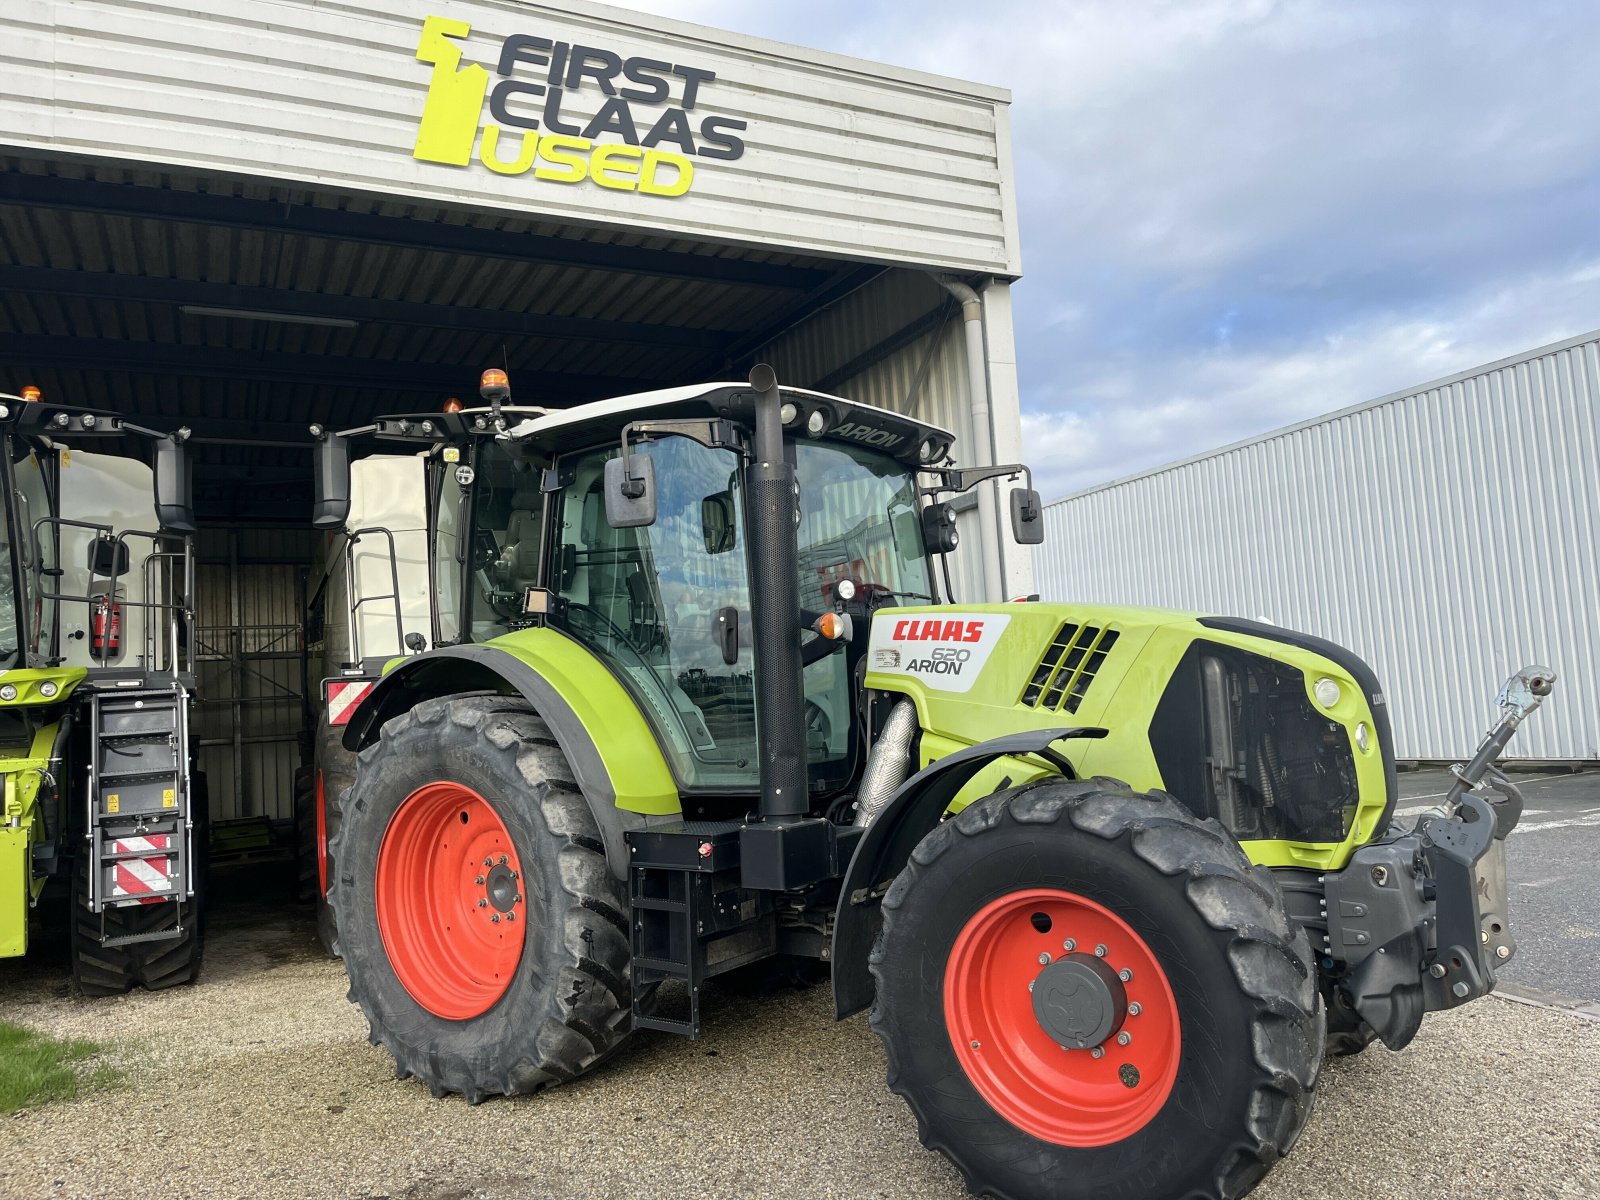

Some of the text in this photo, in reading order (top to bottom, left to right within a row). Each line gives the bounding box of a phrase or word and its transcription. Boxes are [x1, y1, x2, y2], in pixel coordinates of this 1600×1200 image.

[497, 33, 716, 110] FIRST
[489, 79, 748, 161] CLAAS
[479, 125, 694, 197] USED
[828, 422, 904, 448] ARION
[892, 620, 985, 643] CLAAS
[905, 658, 963, 675] ARION
[931, 647, 971, 662] 620
